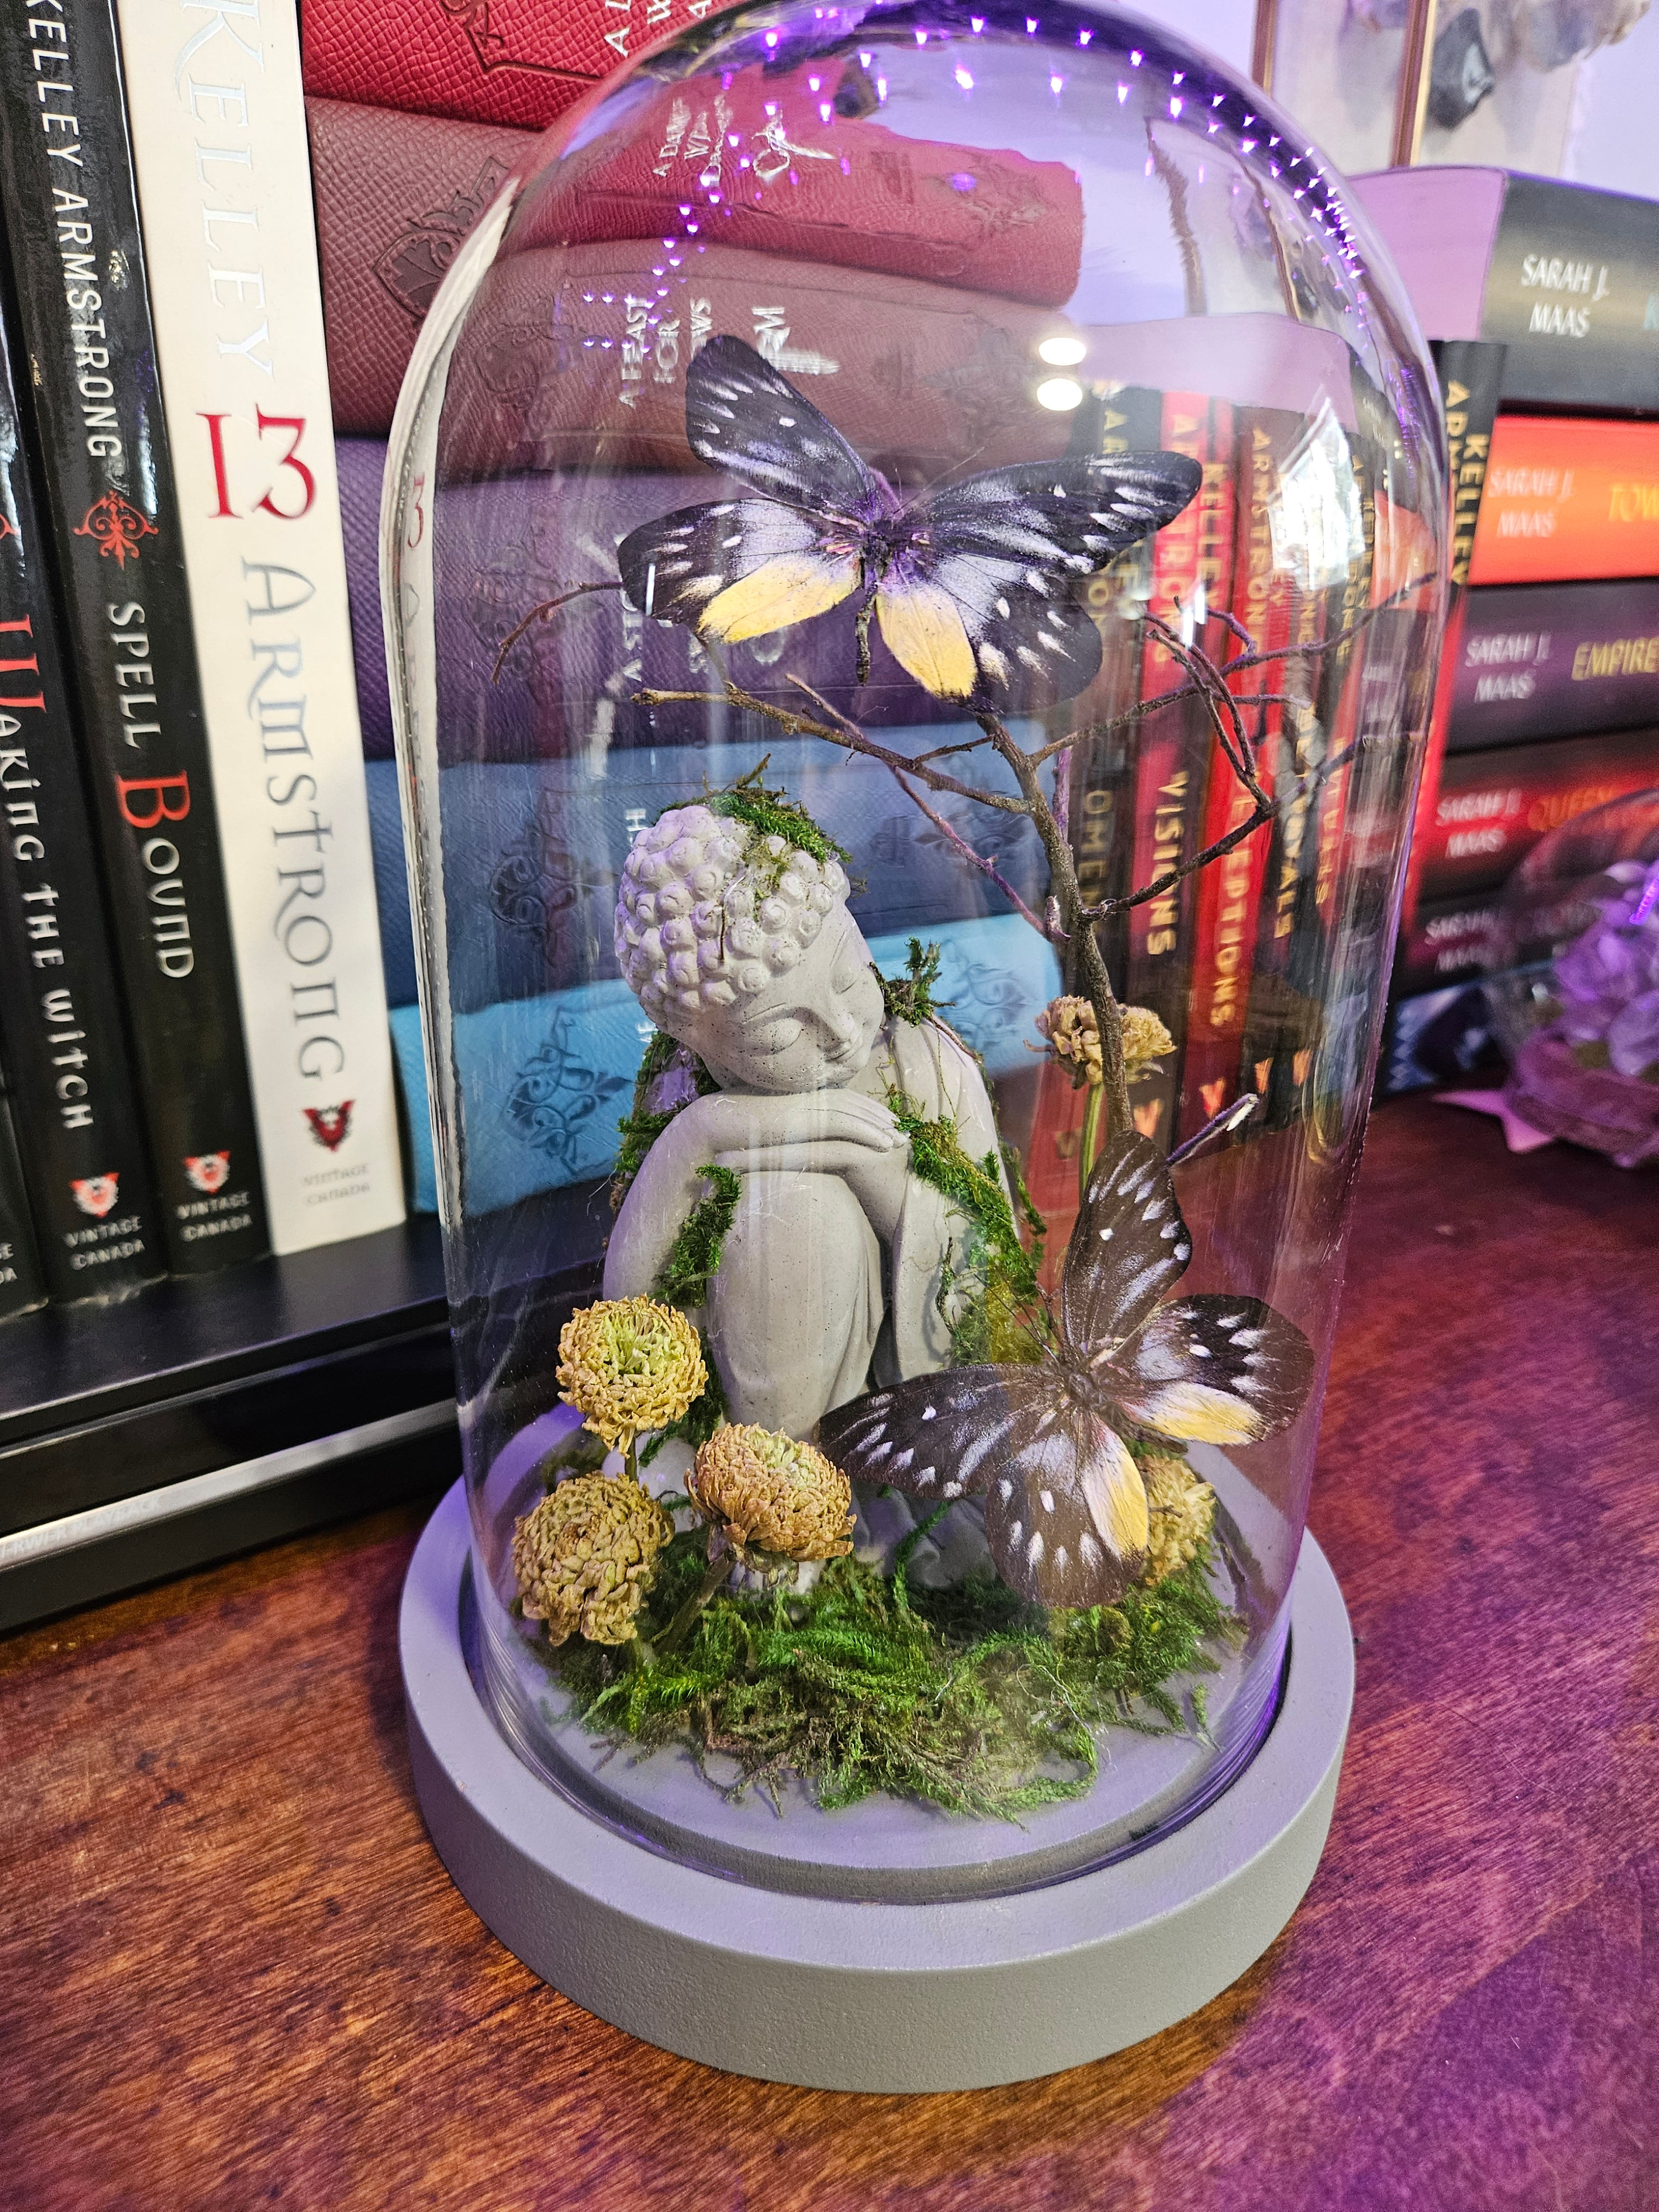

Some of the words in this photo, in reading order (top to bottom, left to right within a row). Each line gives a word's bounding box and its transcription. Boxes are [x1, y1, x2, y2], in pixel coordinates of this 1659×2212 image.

[174, 0, 275, 382] KELLEY
[1521, 253, 1594, 294] SARAH
[52, 187, 123, 458] ARMSTRONG
[1528, 302, 1591, 338] MAAS
[196, 403, 317, 520] 13
[1487, 467, 1559, 498] SARAH
[1451, 432, 1492, 586] KELLEY
[1496, 508, 1558, 539] MAAS
[107, 601, 161, 750] SPELL
[1465, 633, 1537, 667] SARAH
[1572, 637, 1659, 681] EMPIRE
[1474, 668, 1537, 703] MAAS
[240, 556, 345, 1080] ARMSTRONG
[116, 769, 195, 979] BOUND
[1076, 790, 1113, 935] OMEN
[1146, 770, 1190, 956] VISIONS
[23, 883, 65, 970] THE
[42, 988, 94, 1129] WITCH
[62, 1215, 142, 1248] VINTAGE
[176, 1190, 250, 1220] VINTAGE
[180, 1213, 252, 1243] CANADA
[70, 1238, 145, 1270] CANADA
